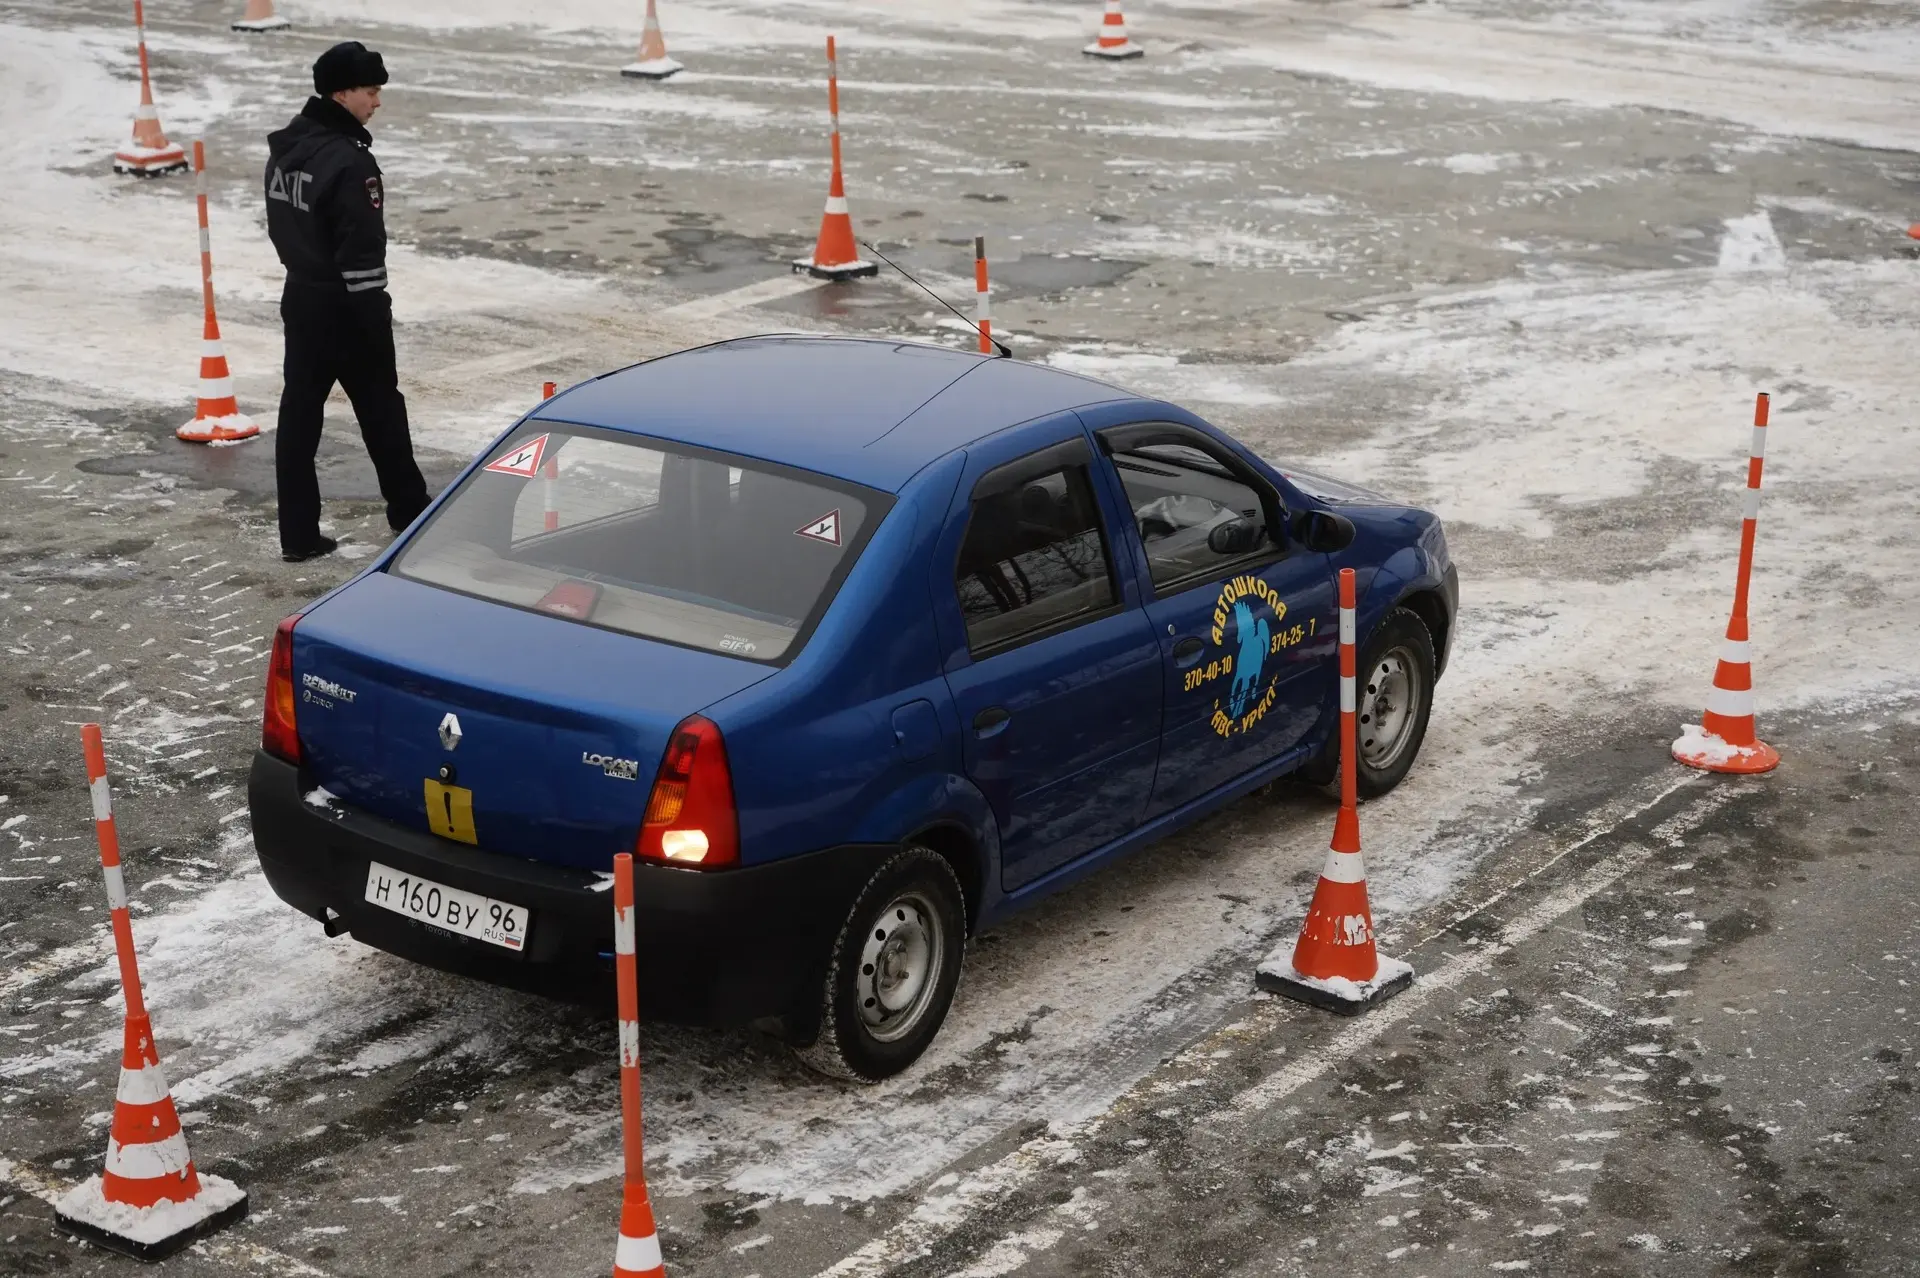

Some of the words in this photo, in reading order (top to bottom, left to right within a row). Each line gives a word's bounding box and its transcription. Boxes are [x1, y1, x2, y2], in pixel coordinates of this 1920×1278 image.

[268, 166, 313, 212] ДПС
[1211, 575, 1288, 646] АВТОШКОЛА
[1184, 655, 1232, 692] 370-40-10
[582, 752, 639, 774] LOGAN
[424, 923, 451, 938] TOYOTA
[484, 928, 505, 942] RUS
